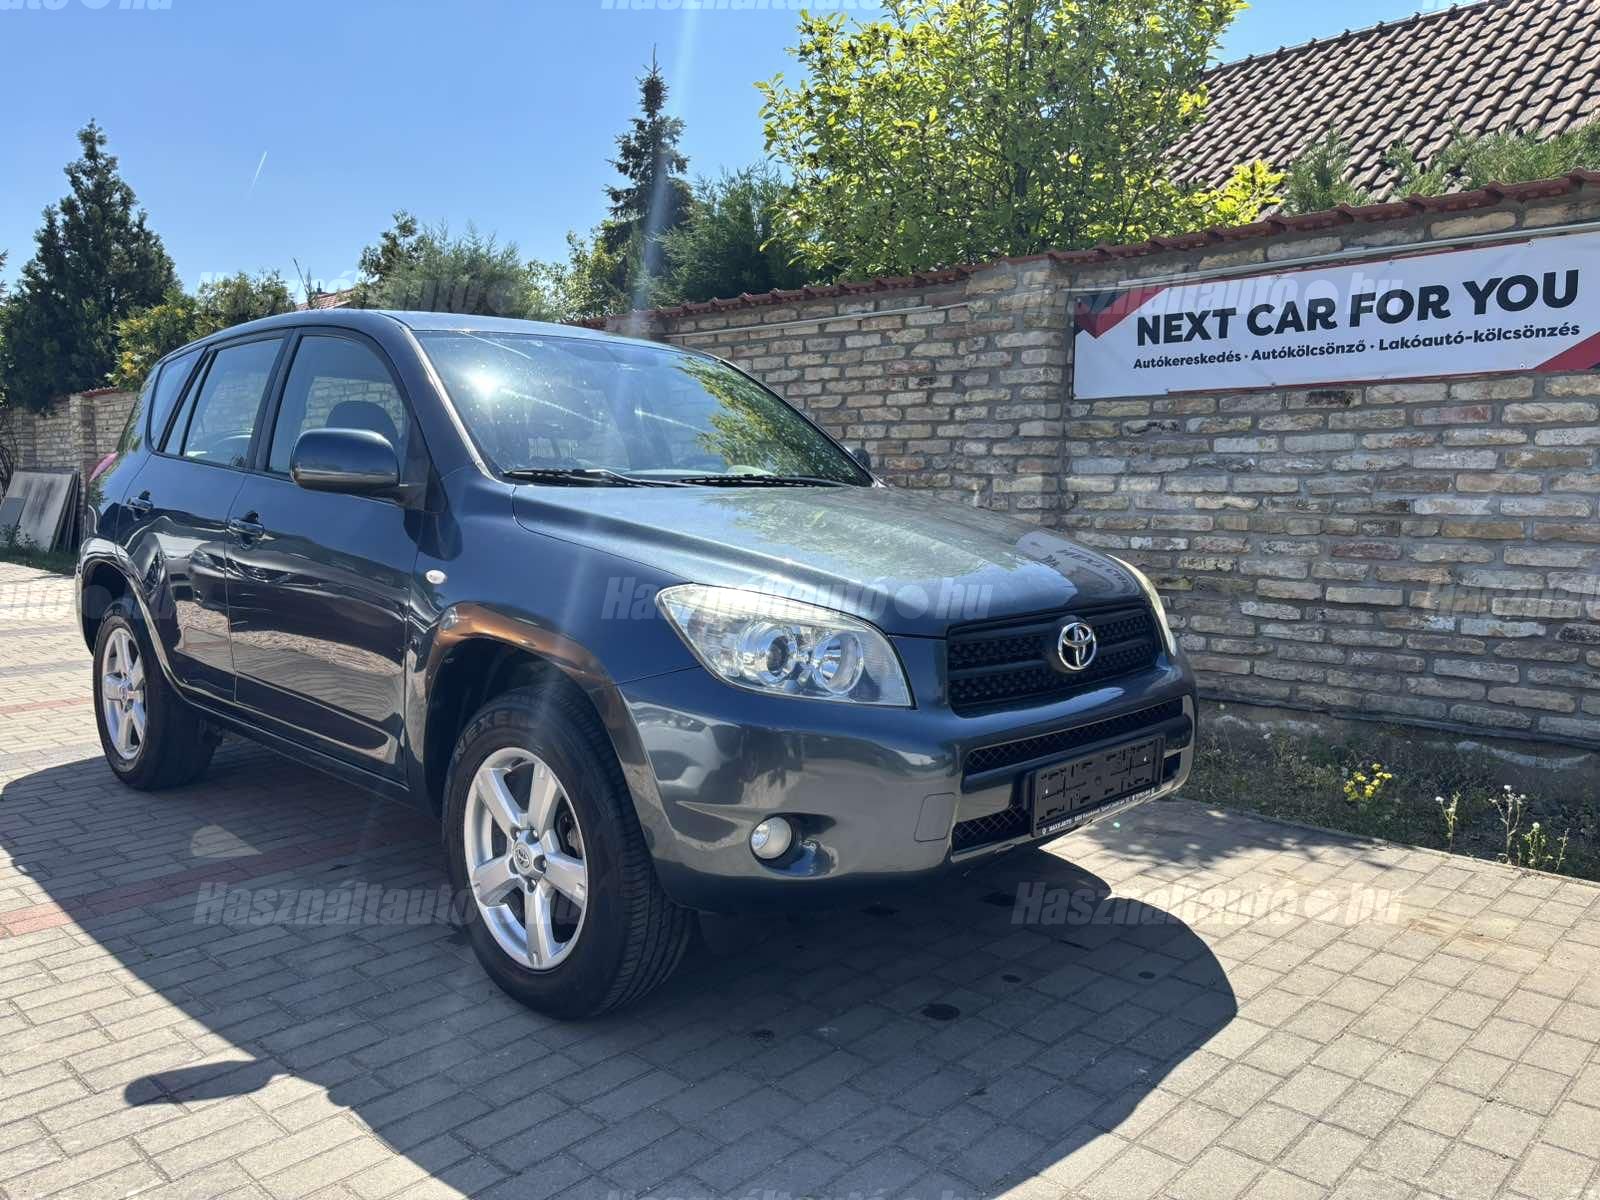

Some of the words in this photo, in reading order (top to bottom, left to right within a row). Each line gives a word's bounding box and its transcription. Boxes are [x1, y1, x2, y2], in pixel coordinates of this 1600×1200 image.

[1137, 307, 1237, 346] NEXT
[1247, 297, 1338, 336] CAR
[1349, 284, 1452, 328] FOR
[1462, 269, 1579, 315] YOU
[1133, 351, 1242, 369] Autókereskedés
[1251, 339, 1366, 361] Autókölcsönző
[1379, 321, 1581, 351] Lakóautó-kölcsönzés
